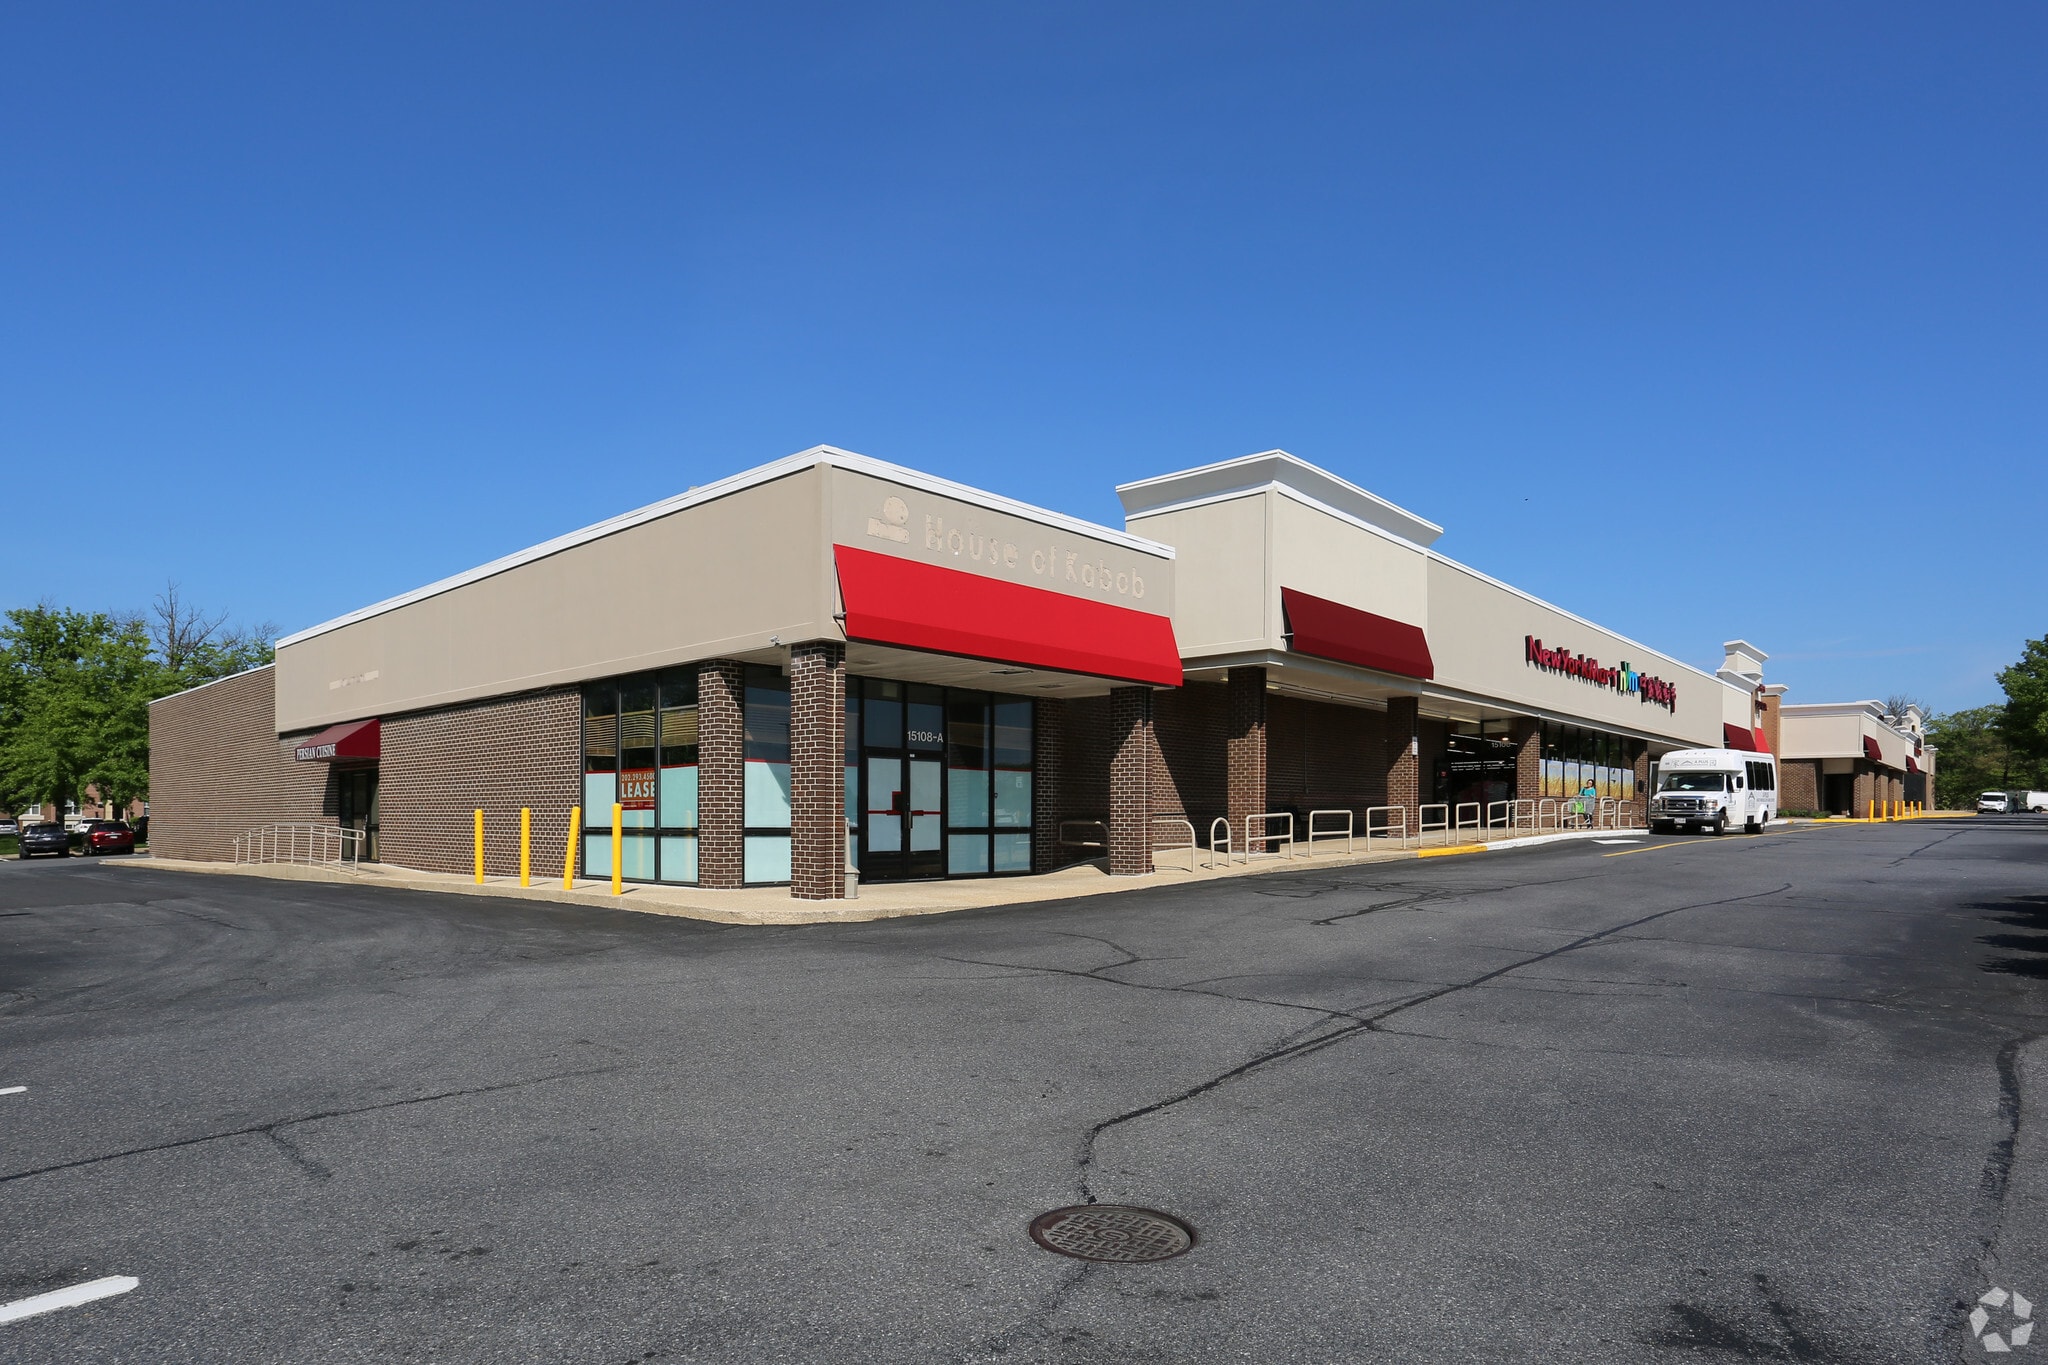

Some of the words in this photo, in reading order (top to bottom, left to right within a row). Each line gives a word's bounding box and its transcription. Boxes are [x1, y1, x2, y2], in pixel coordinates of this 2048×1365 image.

[925, 513, 1019, 569] House
[1031, 545, 1057, 578] of
[1065, 549, 1145, 599] Kabob
[907, 731, 944, 743] 15108-A
[297, 747, 316, 760] PERSIAN
[316, 744, 335, 758] CUISINE
[622, 781, 655, 797] LEASE
